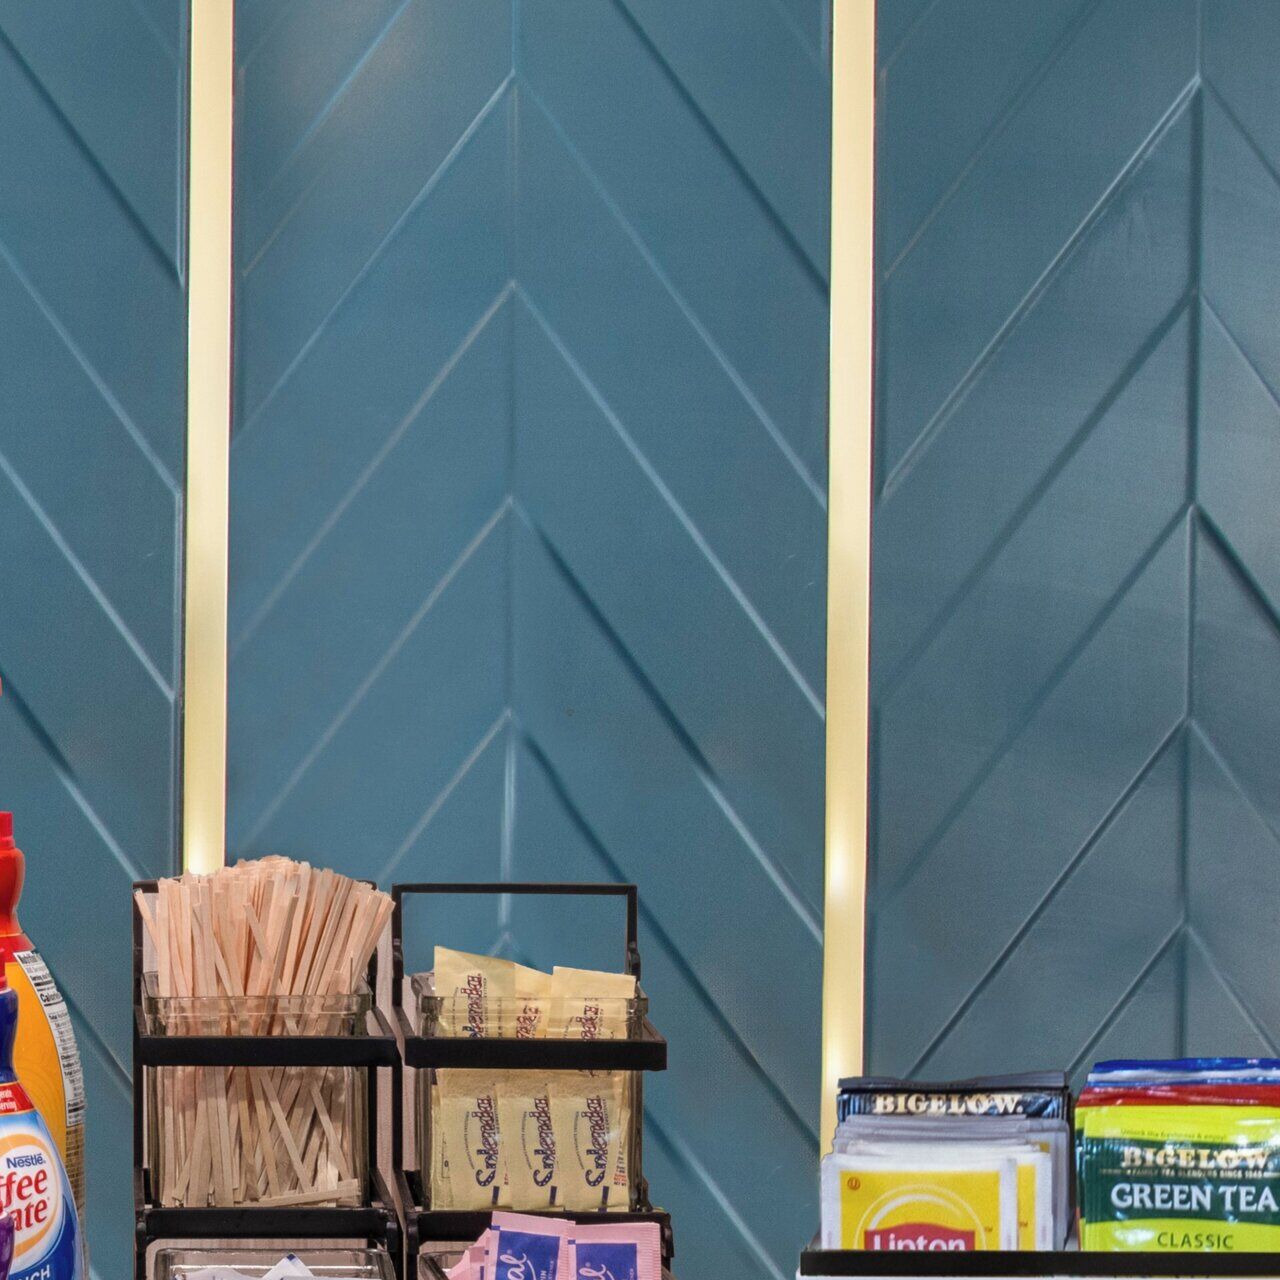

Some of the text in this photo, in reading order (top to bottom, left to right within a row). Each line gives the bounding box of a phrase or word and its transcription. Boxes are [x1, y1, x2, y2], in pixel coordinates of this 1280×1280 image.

[471, 1096, 499, 1187] Splenda
[528, 1096, 556, 1187] Splenda
[581, 1096, 608, 1187] Splenda
[6, 1153, 44, 1169] Nestlé
[1110, 1183, 1280, 1212] GREEN TEA
[10, 1198, 48, 1232] ate
[1156, 1231, 1234, 1249] CLASSIC
